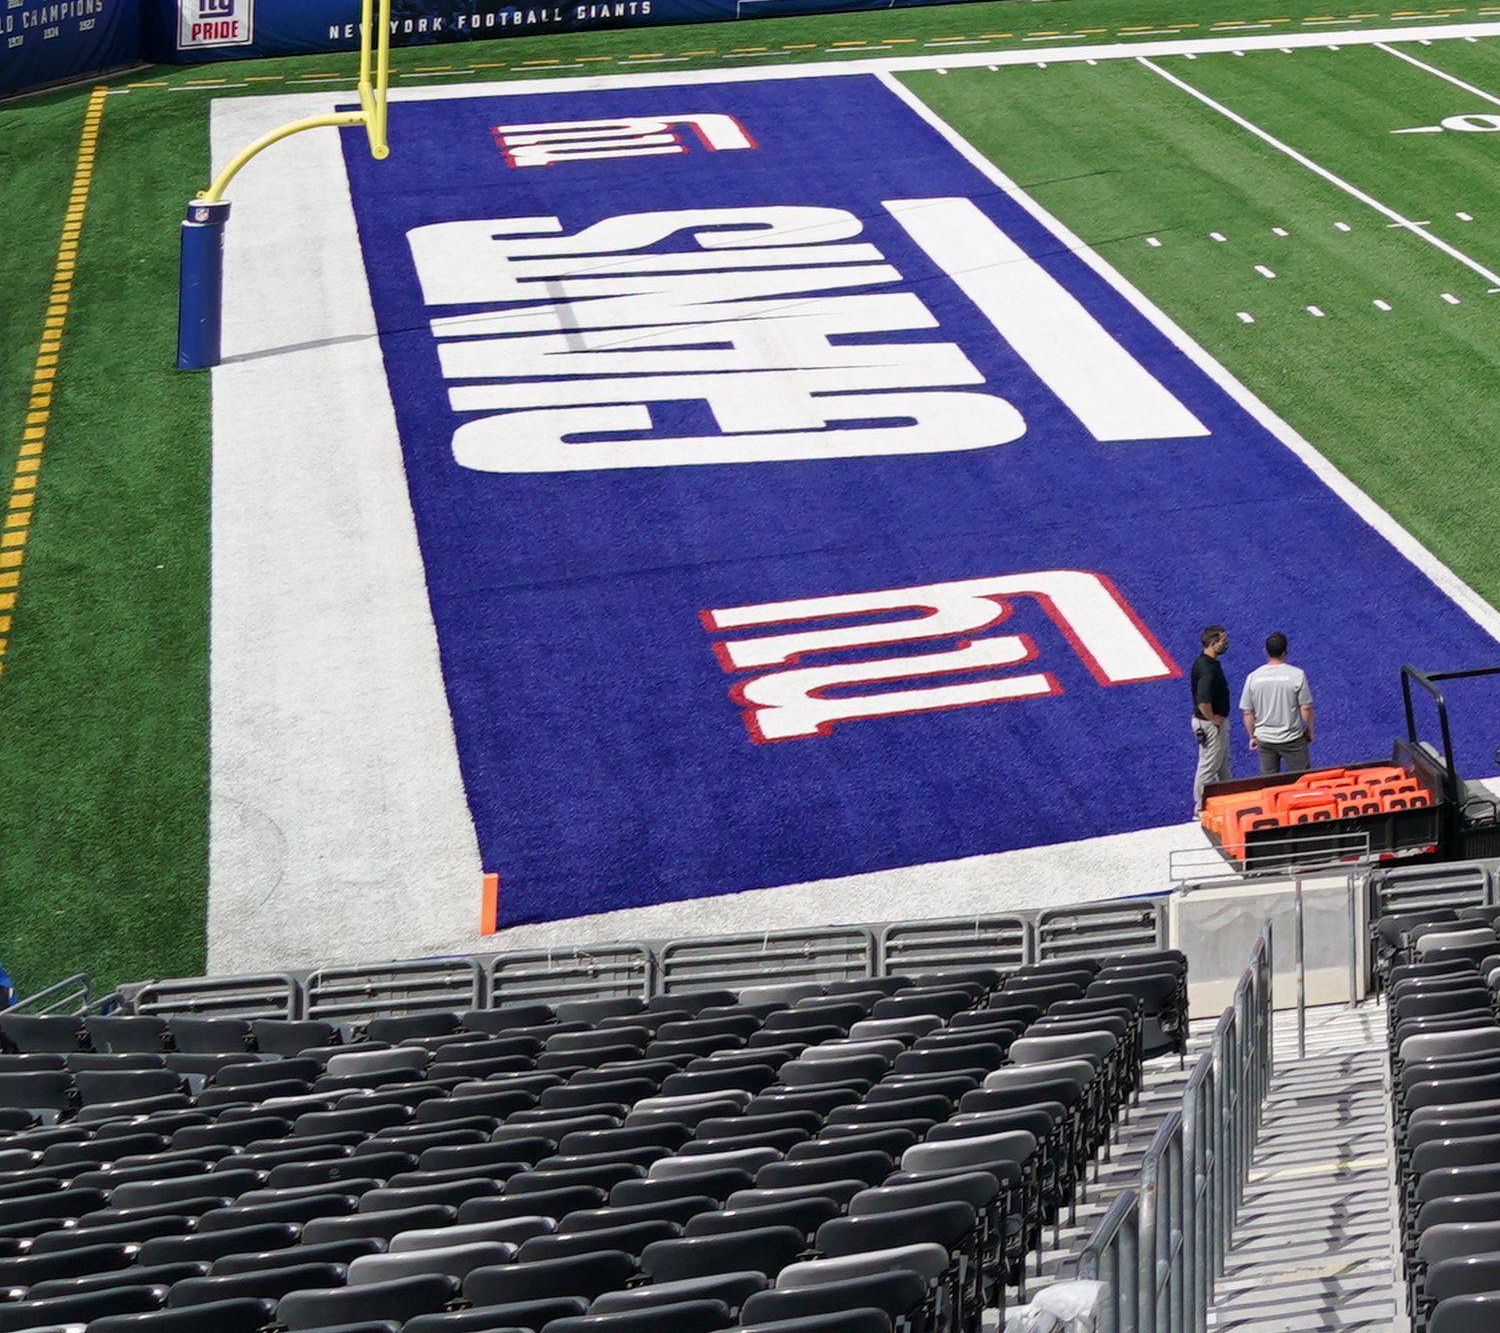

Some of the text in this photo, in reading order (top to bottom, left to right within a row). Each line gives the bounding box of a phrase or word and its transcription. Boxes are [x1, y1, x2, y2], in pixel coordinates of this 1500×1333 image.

[191, 20, 238, 42] PRIDE
[389, 1, 651, 34] YORK FOOTBALL GIANTS
[491, 113, 757, 167] ny
[405, 205, 1028, 473] GIANTS
[697, 569, 1182, 744] ny
